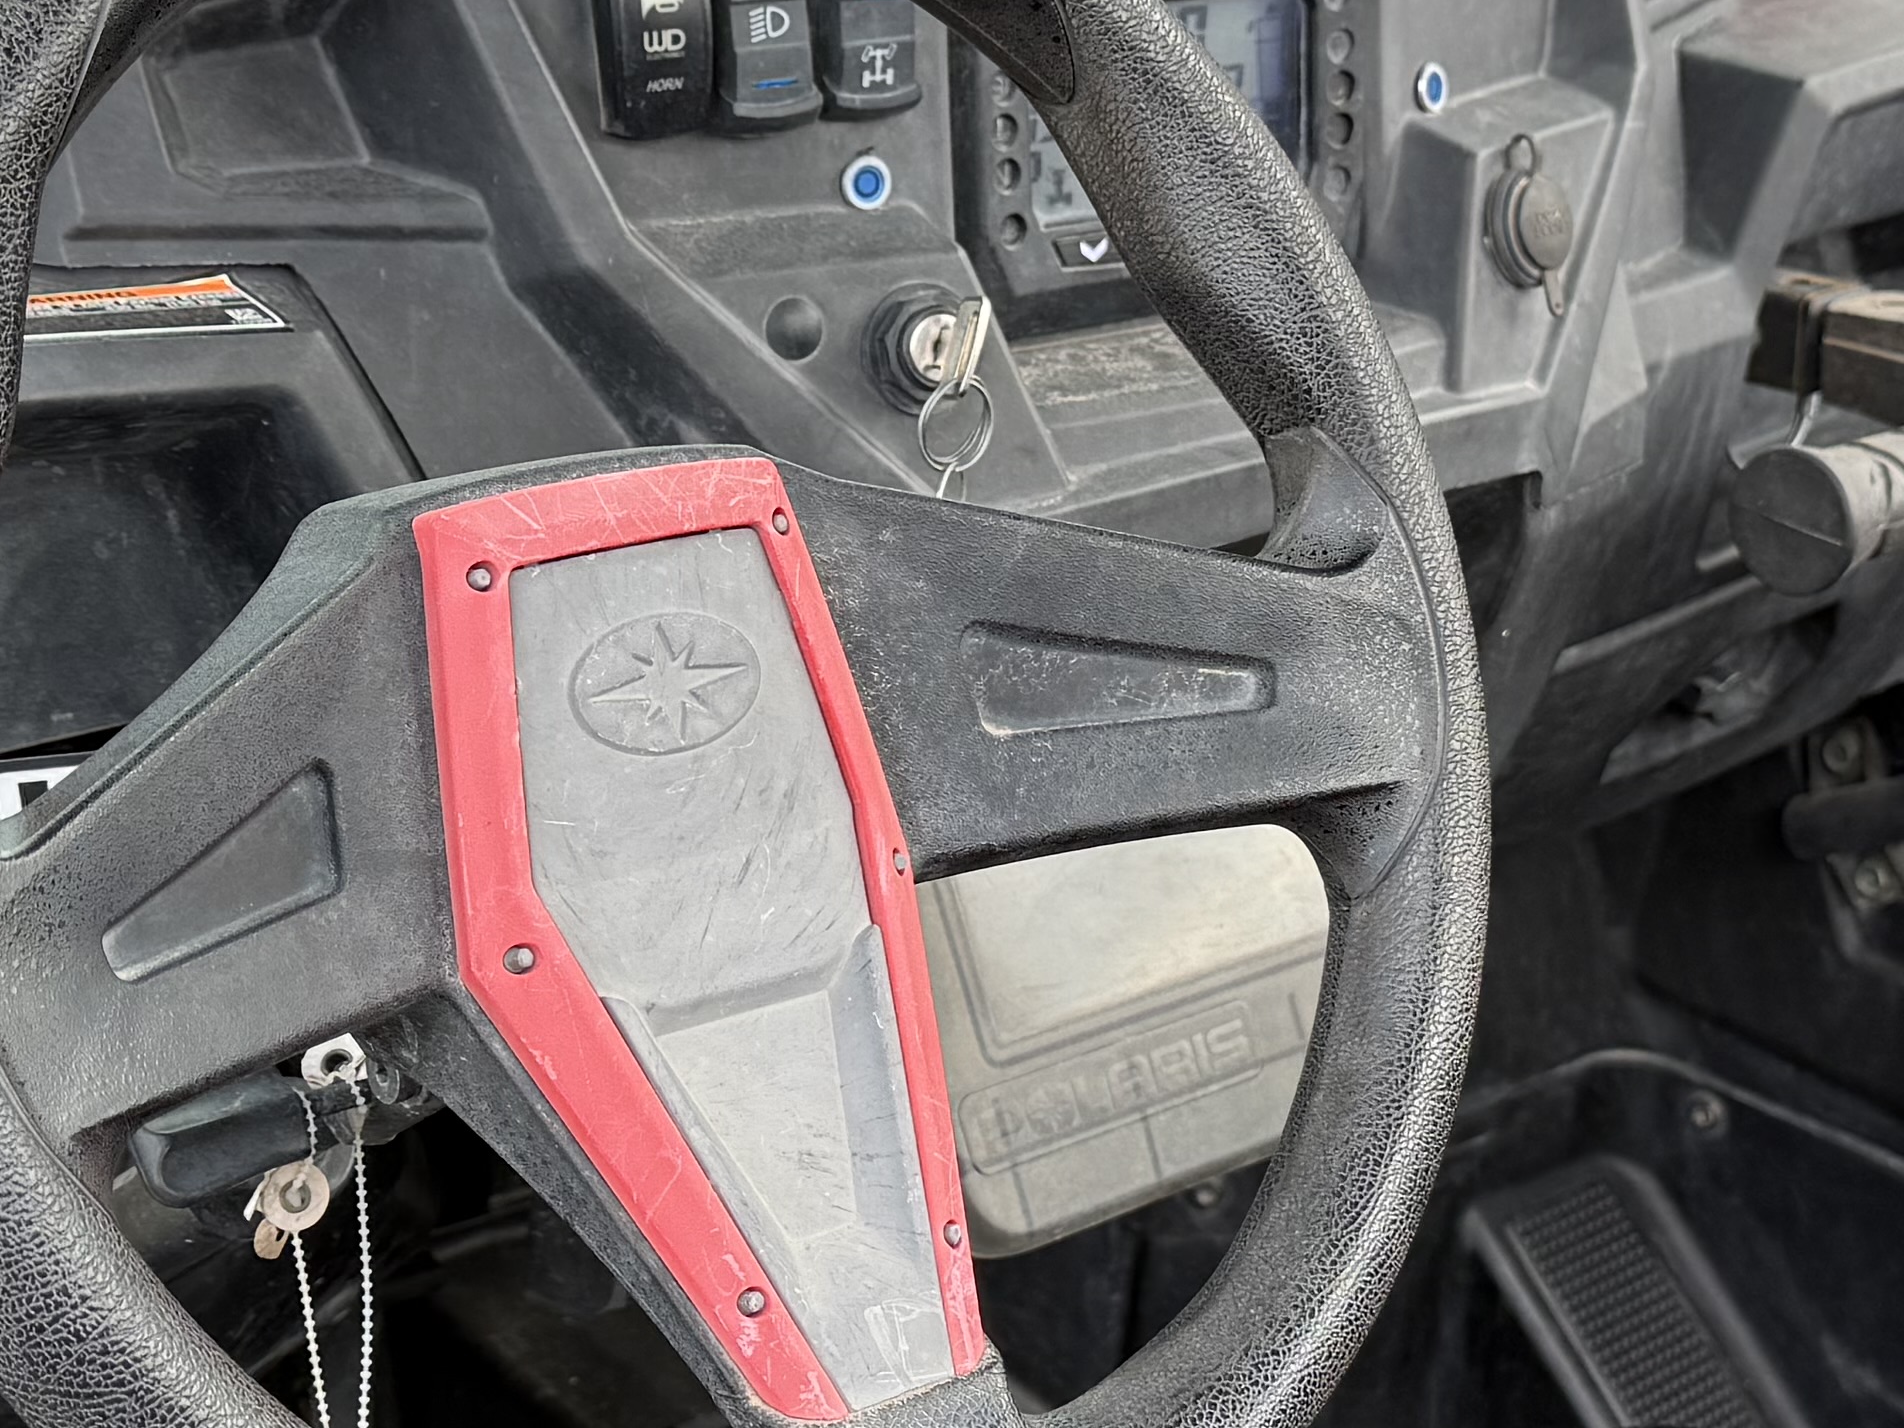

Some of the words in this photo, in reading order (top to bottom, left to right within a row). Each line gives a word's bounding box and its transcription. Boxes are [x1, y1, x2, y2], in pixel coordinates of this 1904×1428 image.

[643, 28, 686, 53] WD
[646, 76, 684, 93] HORN
[29, 292, 138, 304] ARNING
